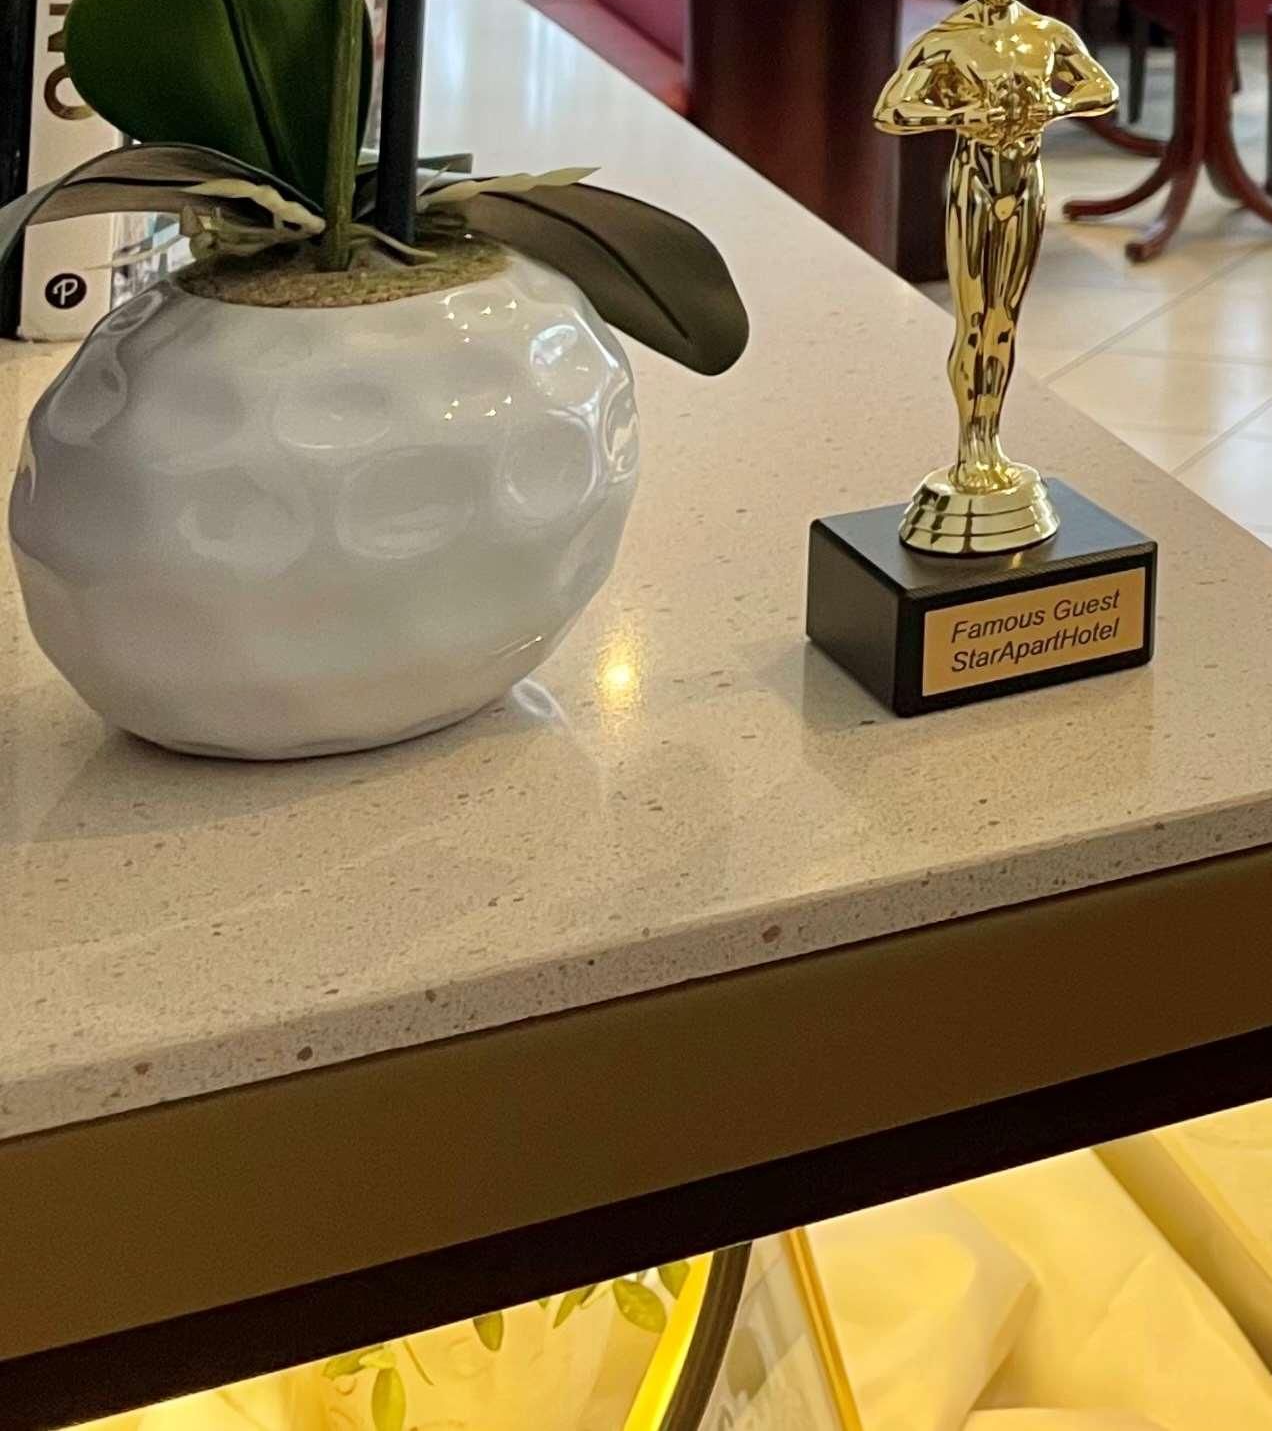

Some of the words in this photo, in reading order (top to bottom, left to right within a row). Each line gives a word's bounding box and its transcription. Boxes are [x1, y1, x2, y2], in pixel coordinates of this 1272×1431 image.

[951, 607, 1046, 644] Famous
[1053, 589, 1121, 621] Guest
[951, 617, 1121, 673] StarApartHotel
